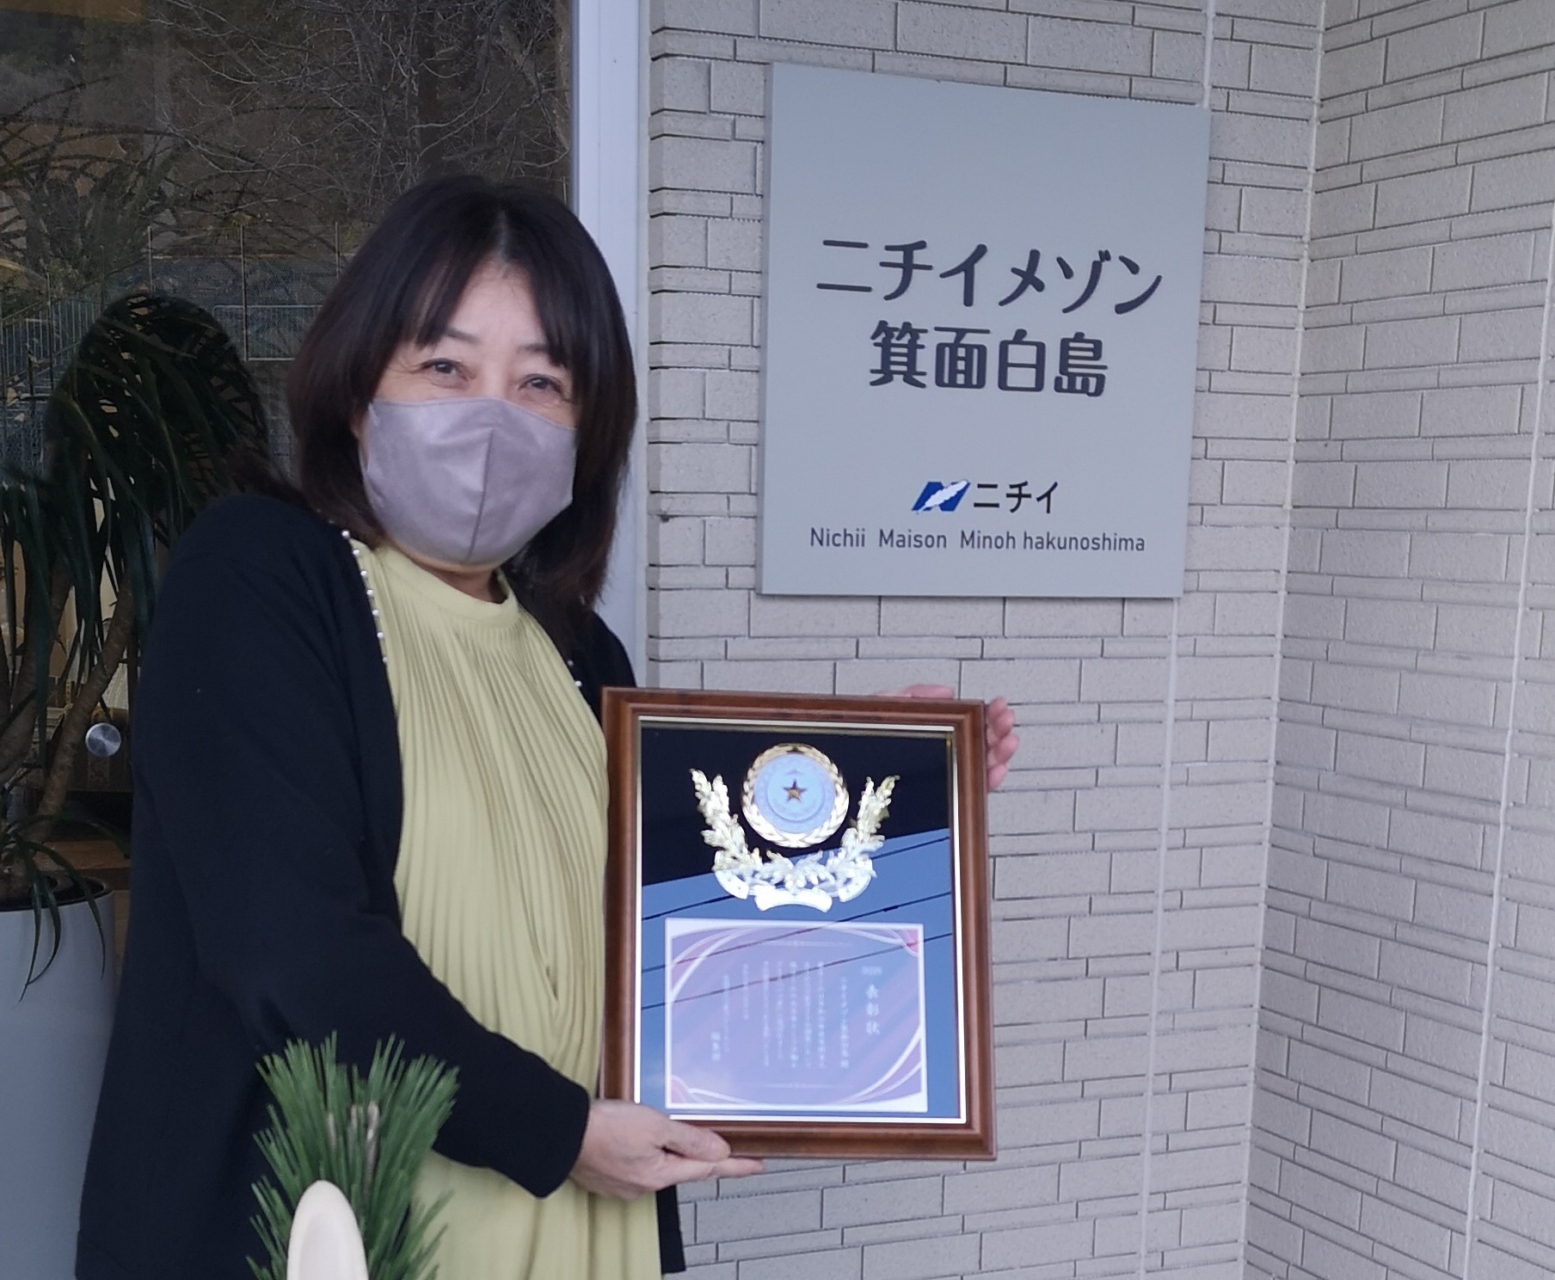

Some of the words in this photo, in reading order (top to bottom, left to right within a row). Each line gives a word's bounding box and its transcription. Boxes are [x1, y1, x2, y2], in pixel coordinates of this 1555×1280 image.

[816, 239, 1163, 315] ニチイメゾン
[869, 320, 1109, 397] 箕面白島
[973, 480, 1059, 514] ニチイ
[810, 527, 866, 548] Nichii
[878, 528, 948, 549] Maison
[960, 529, 1017, 550] Minoh
[1022, 530, 1146, 552] hakunoshima
